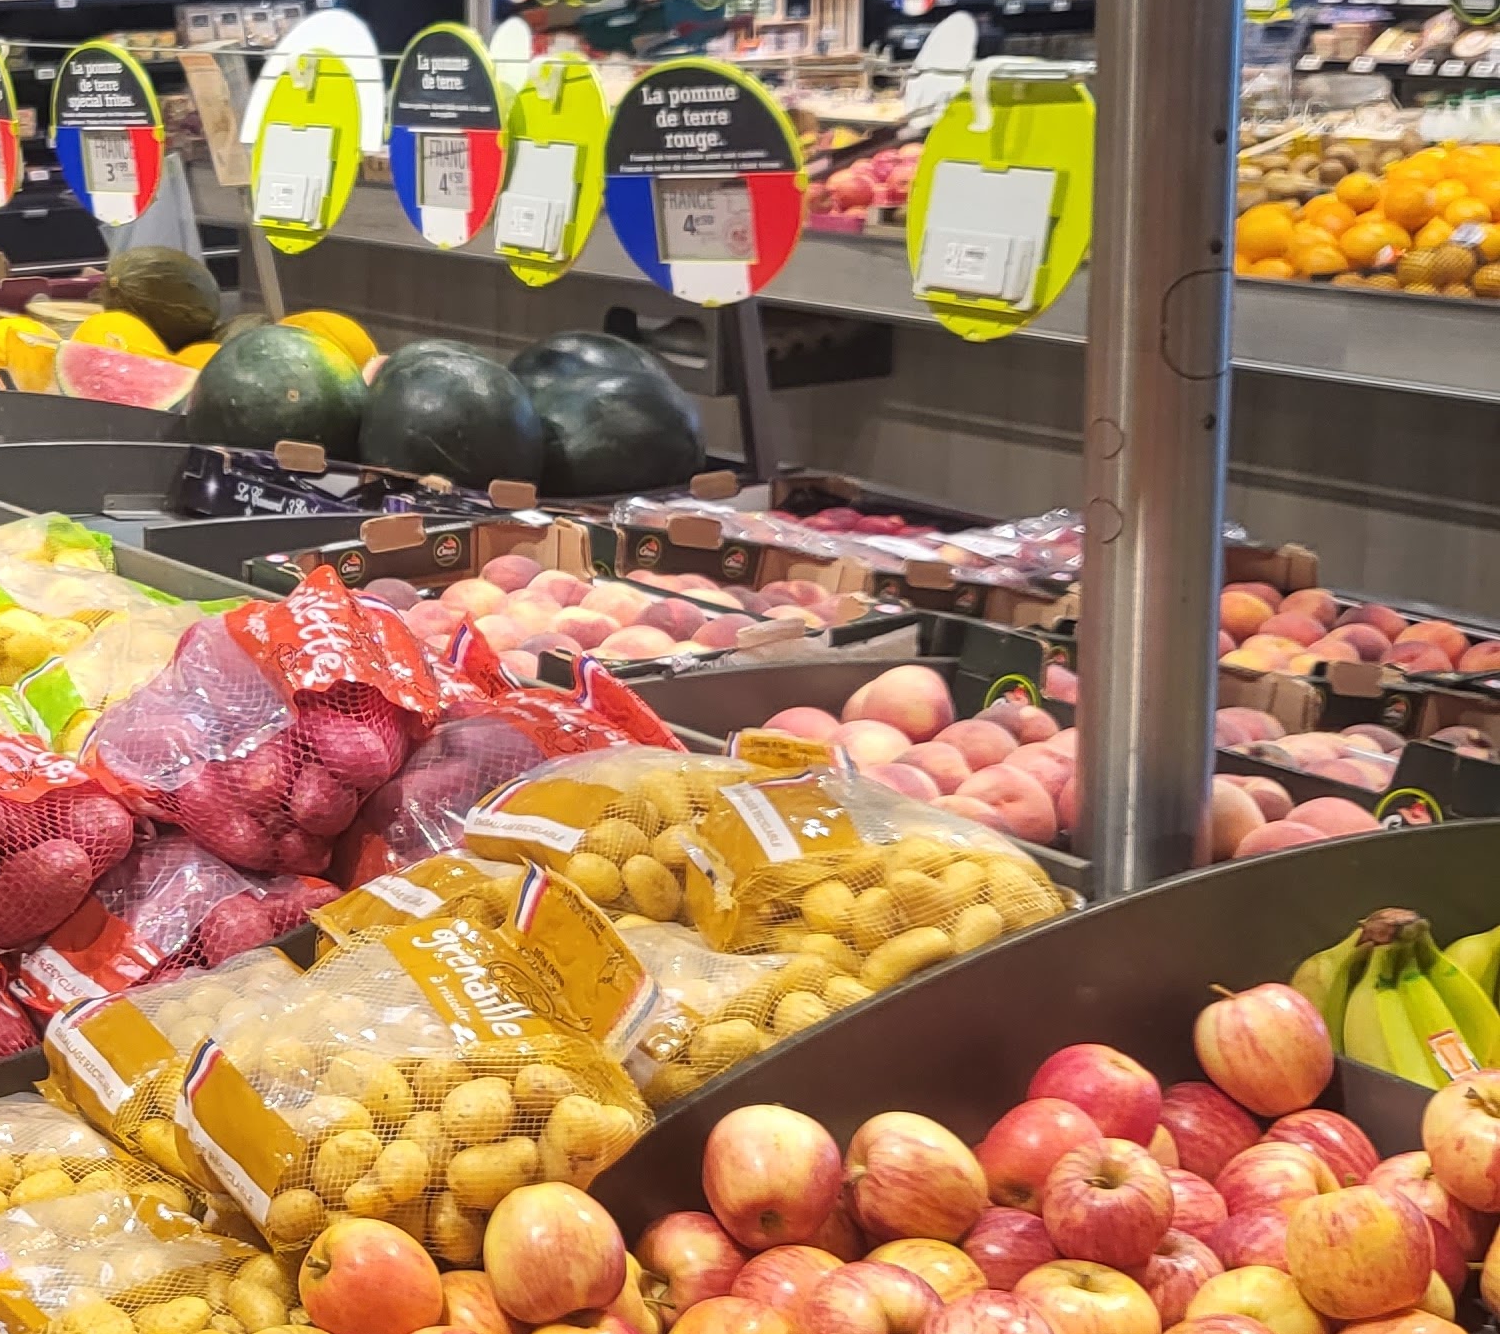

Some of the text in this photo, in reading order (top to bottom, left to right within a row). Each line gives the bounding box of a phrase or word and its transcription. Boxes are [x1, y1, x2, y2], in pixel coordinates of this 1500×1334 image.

[79, 78, 93, 92] de
[422, 74, 435, 90] de
[641, 84, 738, 108] La pomme
[655, 108, 731, 128] de terre
[665, 132, 728, 152] rouge.
[39, 955, 87, 999] RECYCLAB
[411, 928, 534, 1037] grenaille
